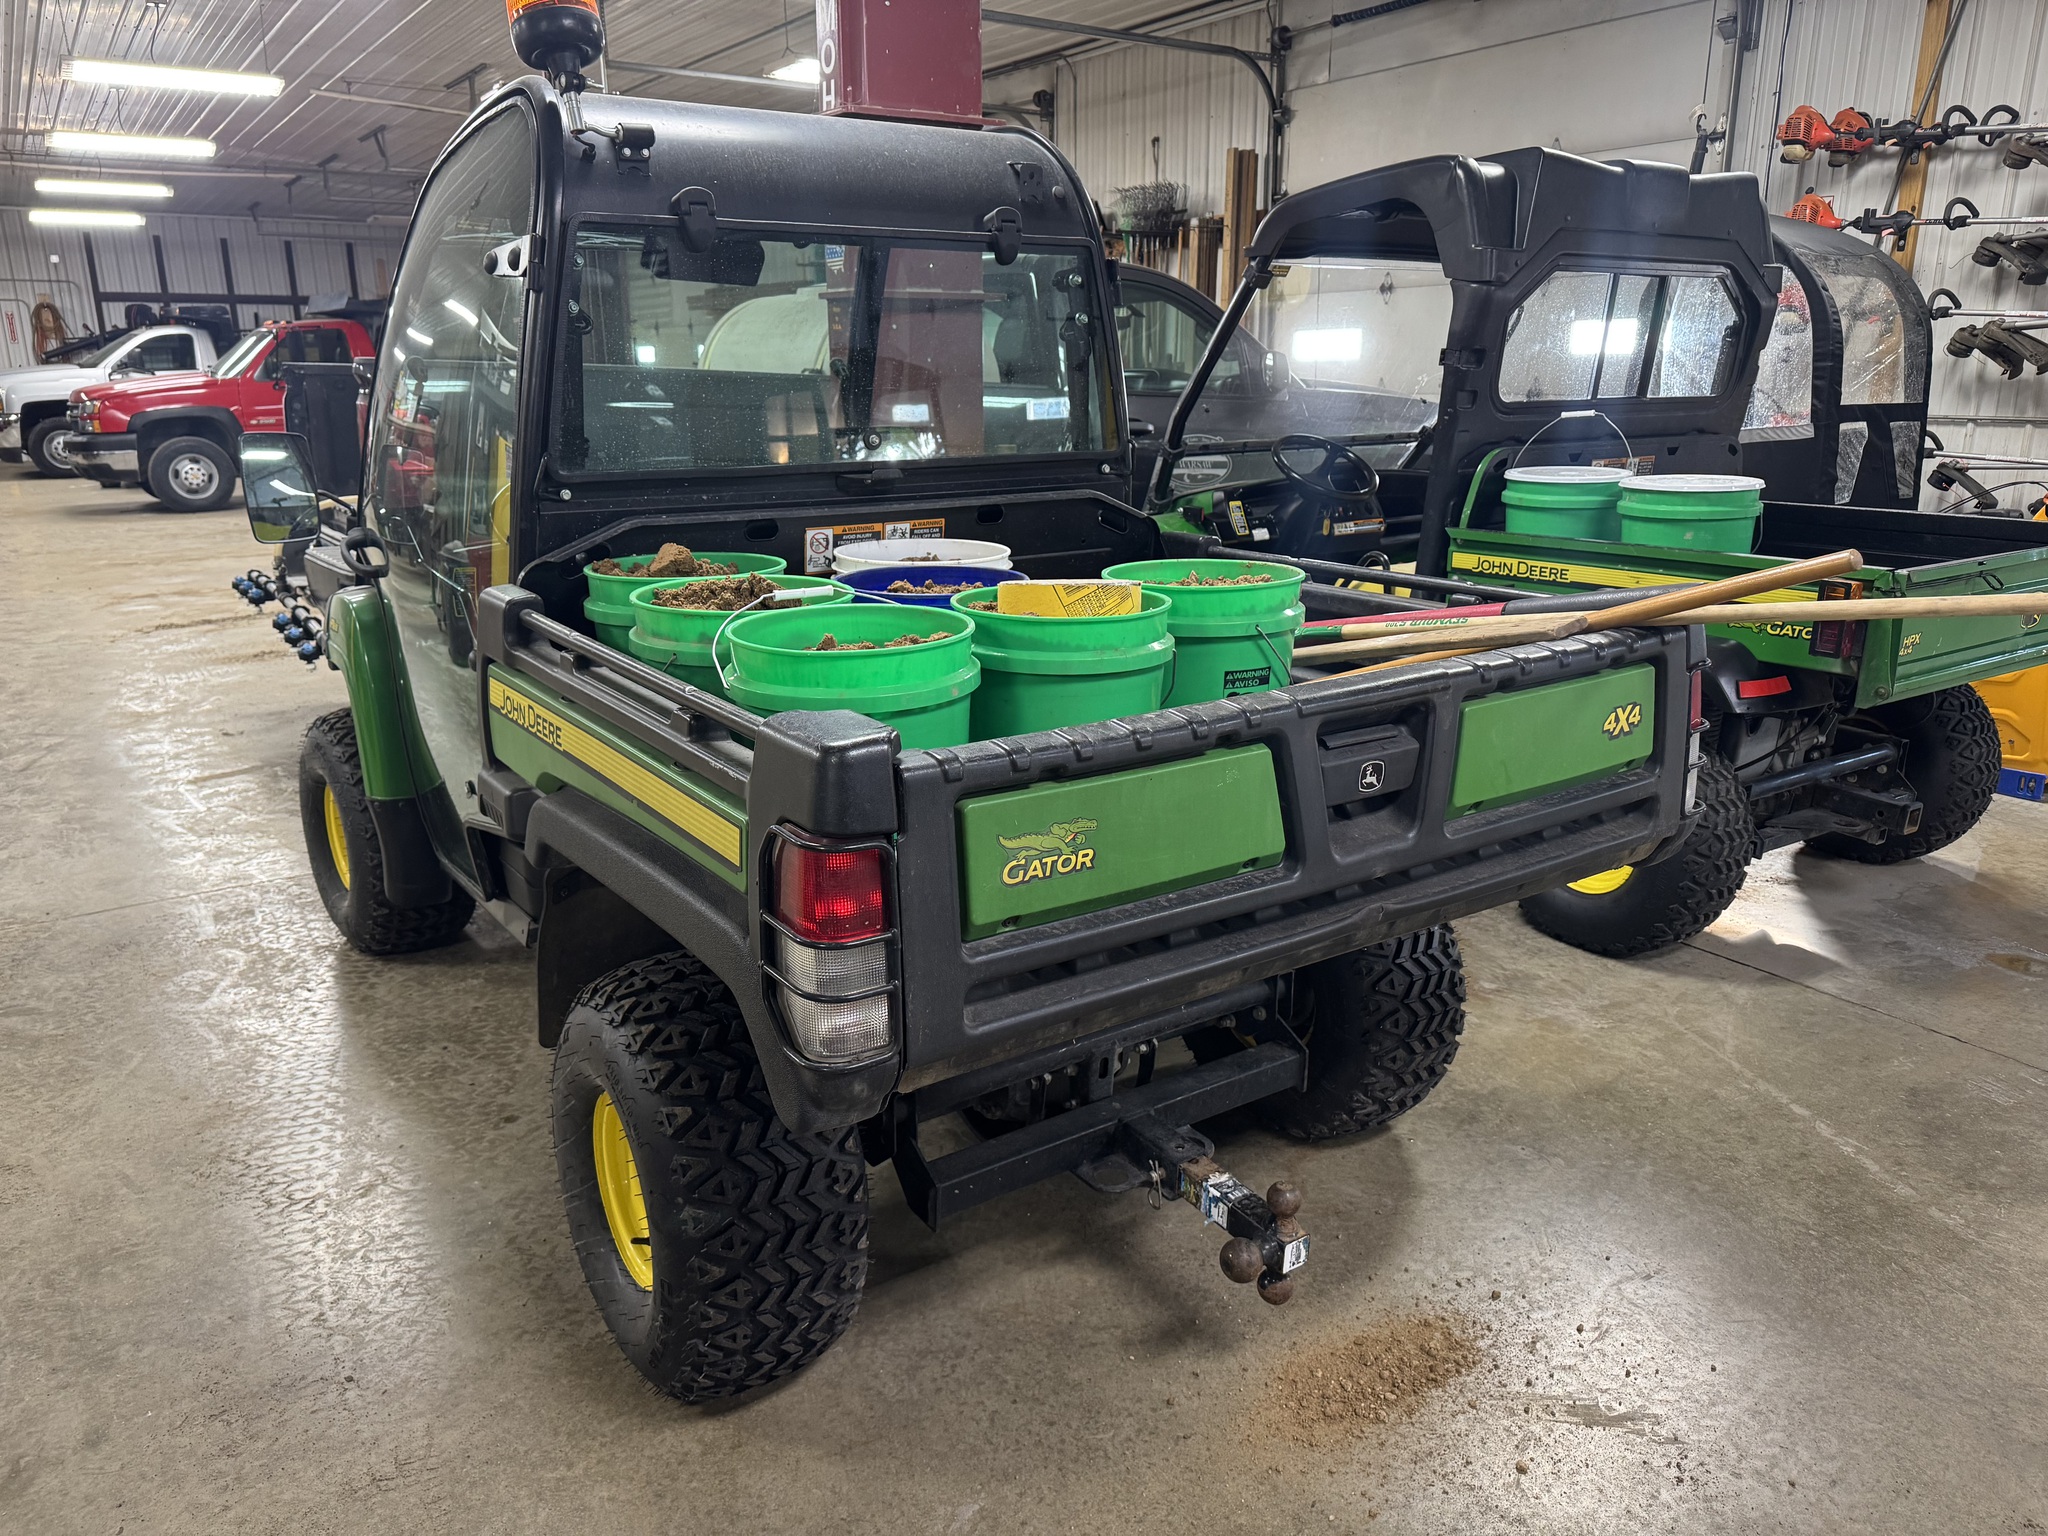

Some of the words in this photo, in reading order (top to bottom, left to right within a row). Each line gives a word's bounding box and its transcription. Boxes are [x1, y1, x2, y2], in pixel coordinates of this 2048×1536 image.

[1472, 556, 1513, 574] JOHN
[1516, 561, 1569, 580] DEERE
[1902, 632, 1922, 648] HPX
[1233, 668, 1270, 680] WARNING
[1233, 678, 1260, 688] AVISO
[500, 689, 526, 727] JOHN
[527, 704, 562, 748] DEERE
[1002, 848, 1095, 885] GATOR
